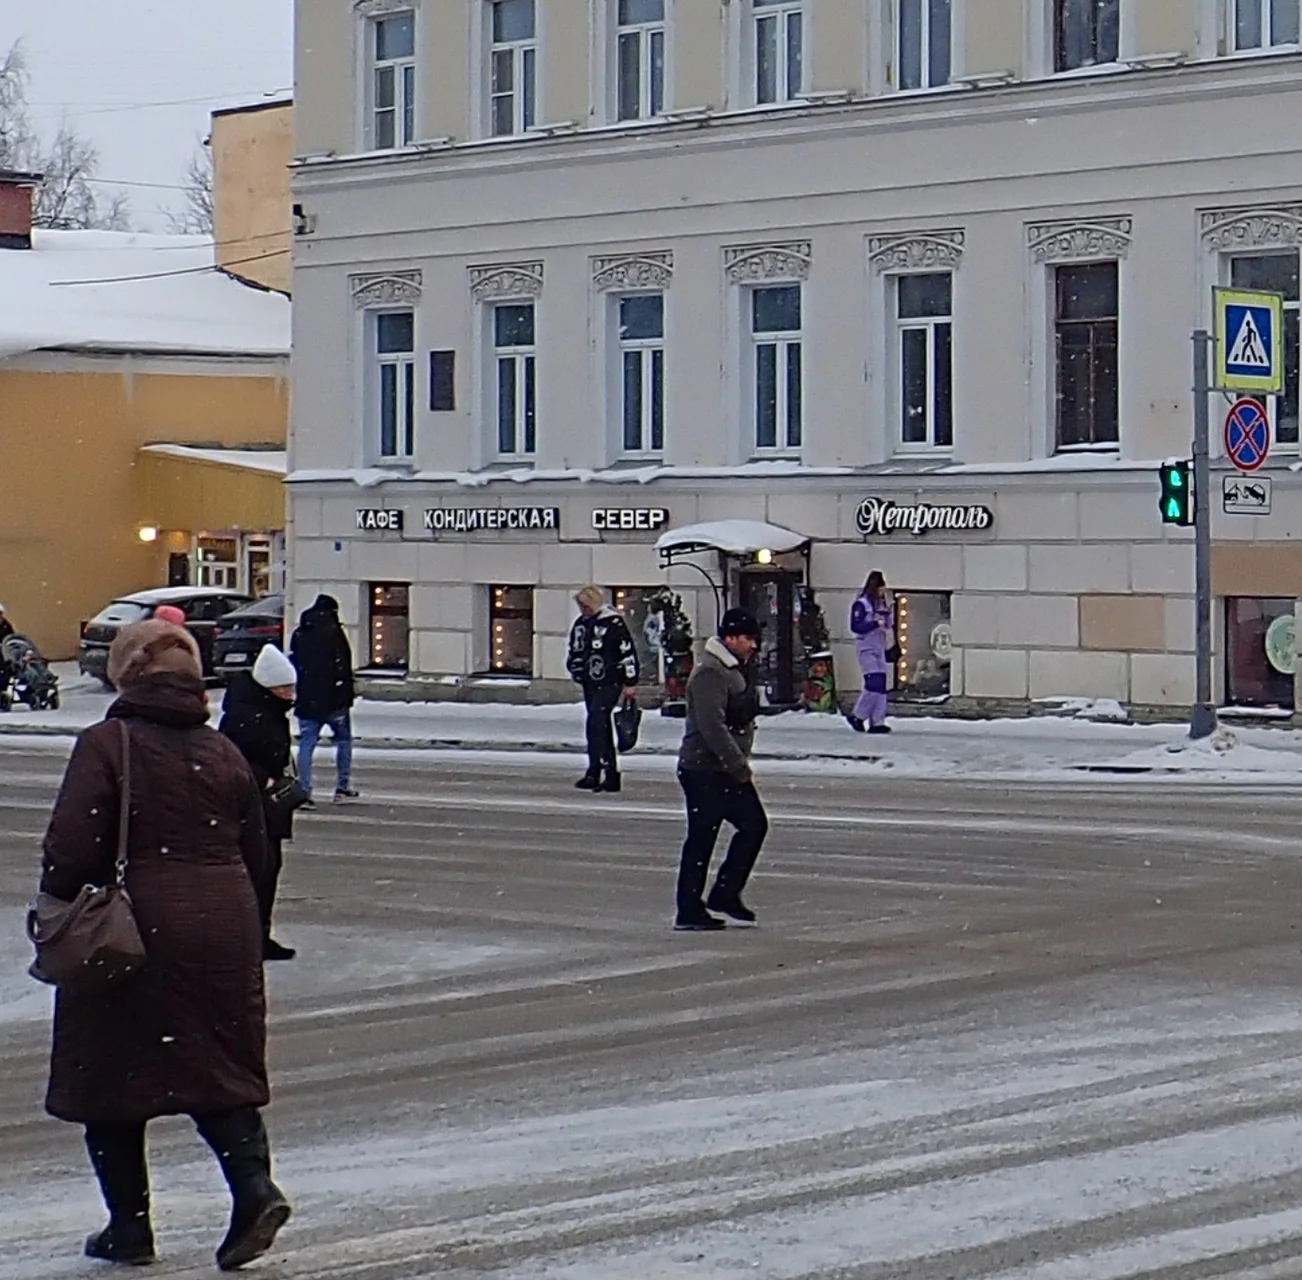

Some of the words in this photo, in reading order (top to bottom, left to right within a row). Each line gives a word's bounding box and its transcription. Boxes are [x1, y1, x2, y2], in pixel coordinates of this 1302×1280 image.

[355, 509, 399, 530] КАФЕ
[423, 507, 556, 532] КОНДИТЕРСКАЯ
[591, 508, 666, 530] СЕВЕР
[854, 497, 990, 535] Метрополь
